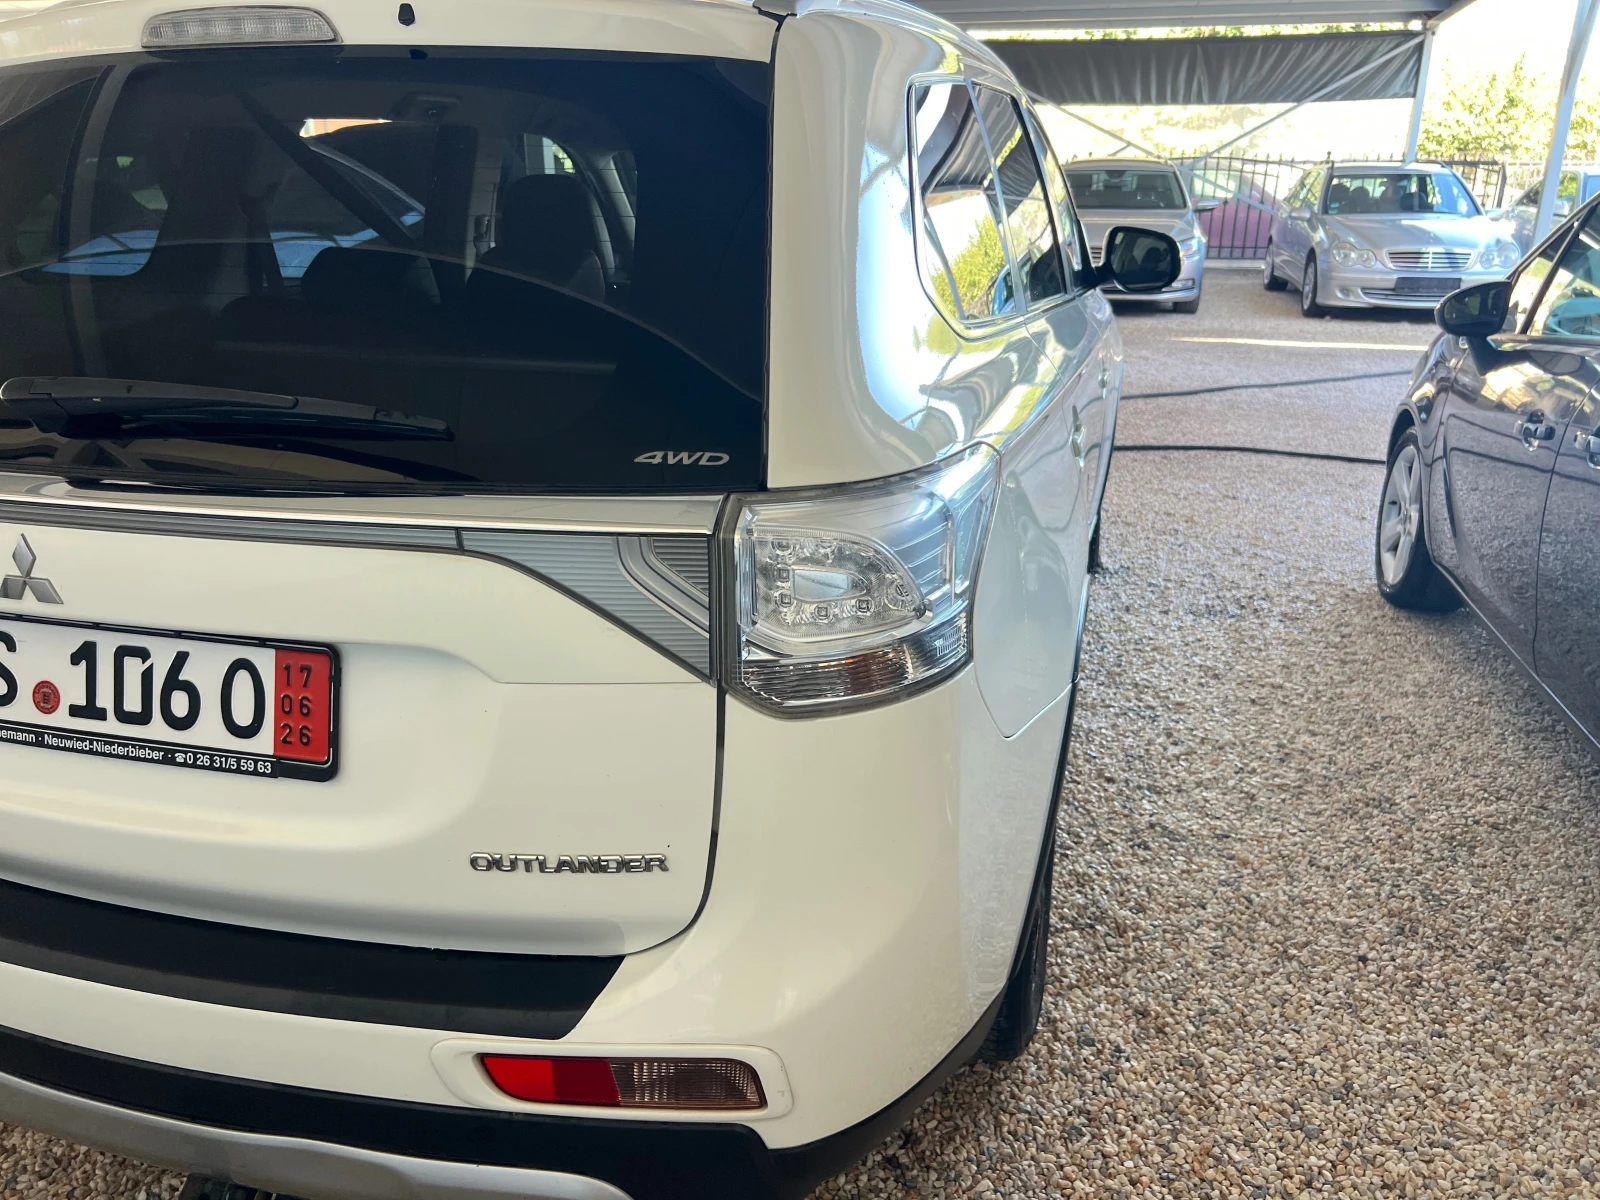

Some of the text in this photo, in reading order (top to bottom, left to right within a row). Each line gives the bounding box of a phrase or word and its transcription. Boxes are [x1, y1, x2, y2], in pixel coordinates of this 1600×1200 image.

[633, 450, 730, 466] 4WD
[283, 663, 312, 688] 17
[281, 693, 311, 717] 06
[281, 722, 311, 746] 26
[0, 729, 36, 743] emann
[44, 734, 164, 760] Neuwied-Niederbieber
[196, 754, 211, 766] 26
[213, 756, 237, 770] 31/5
[240, 759, 255, 772] 59
[257, 761, 272, 774] 63
[469, 852, 670, 874] OUTLANDER
